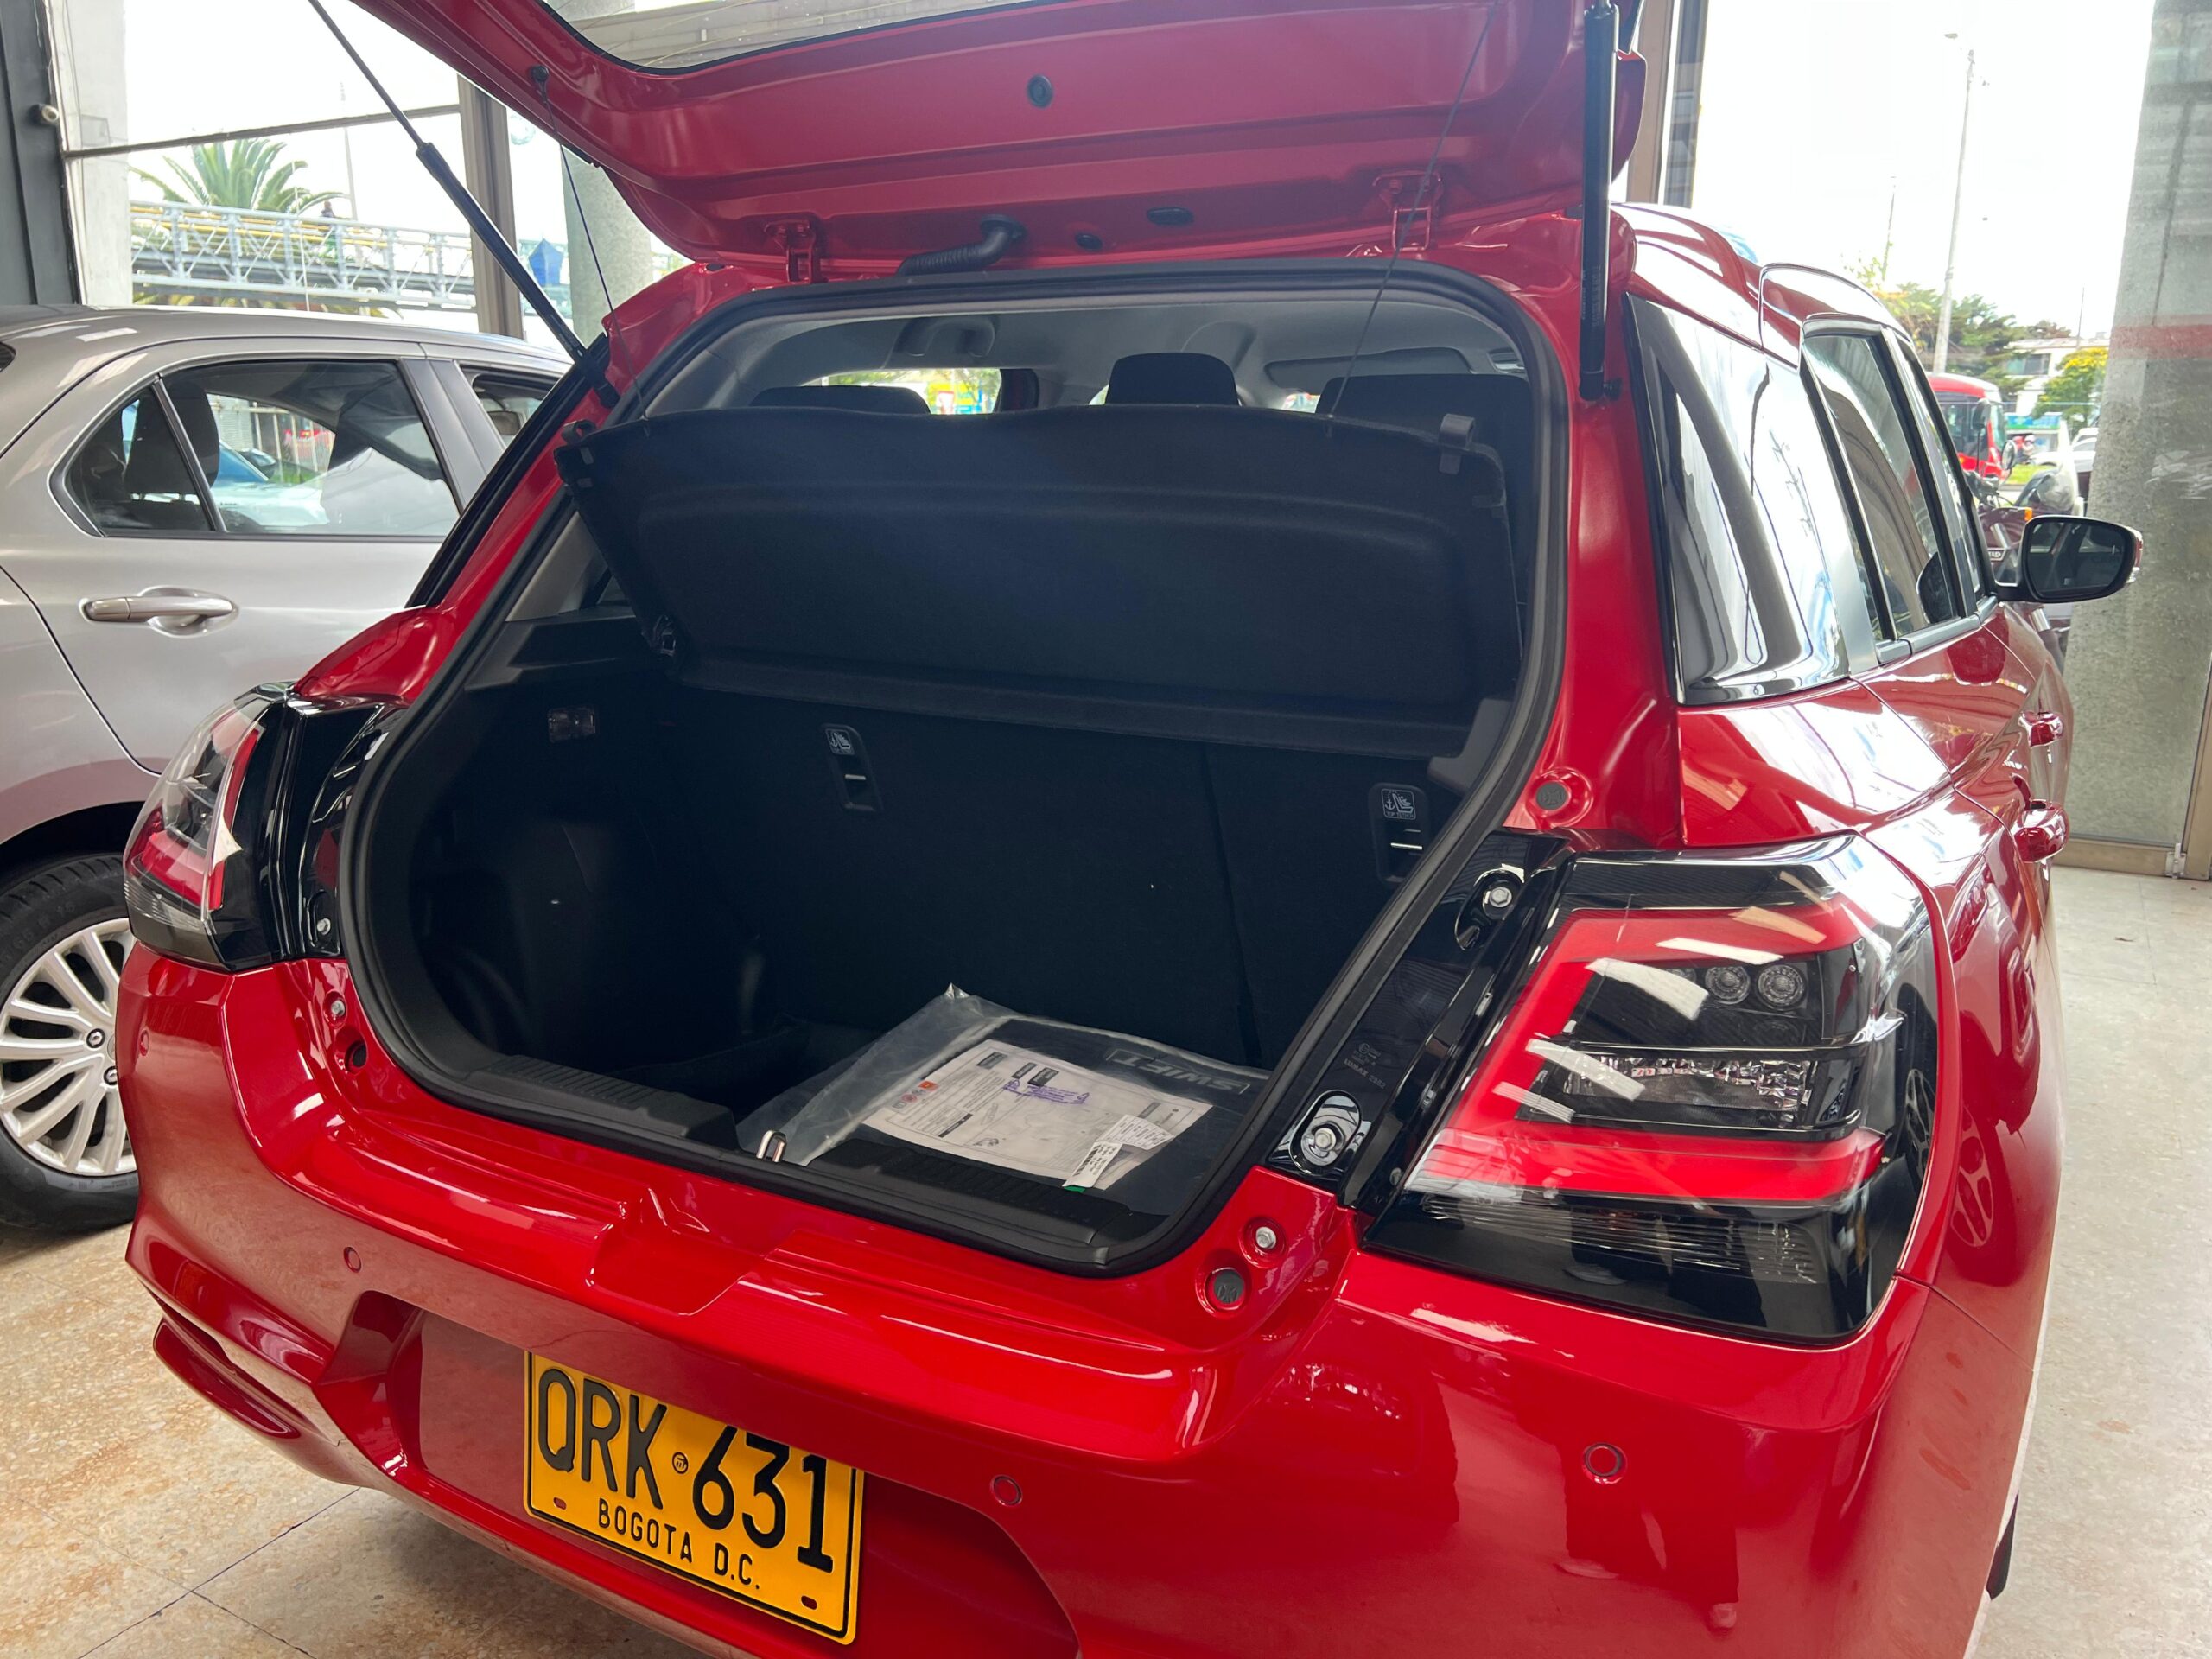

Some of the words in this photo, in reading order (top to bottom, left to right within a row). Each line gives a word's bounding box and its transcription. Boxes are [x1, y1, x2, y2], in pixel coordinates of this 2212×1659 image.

[1112, 1056, 1243, 1090] SWIFT
[537, 1368, 667, 1510] QRK
[692, 1425, 833, 1573] 631
[598, 1497, 693, 1563] BOGOTA
[713, 1542, 760, 1590] D.C.
